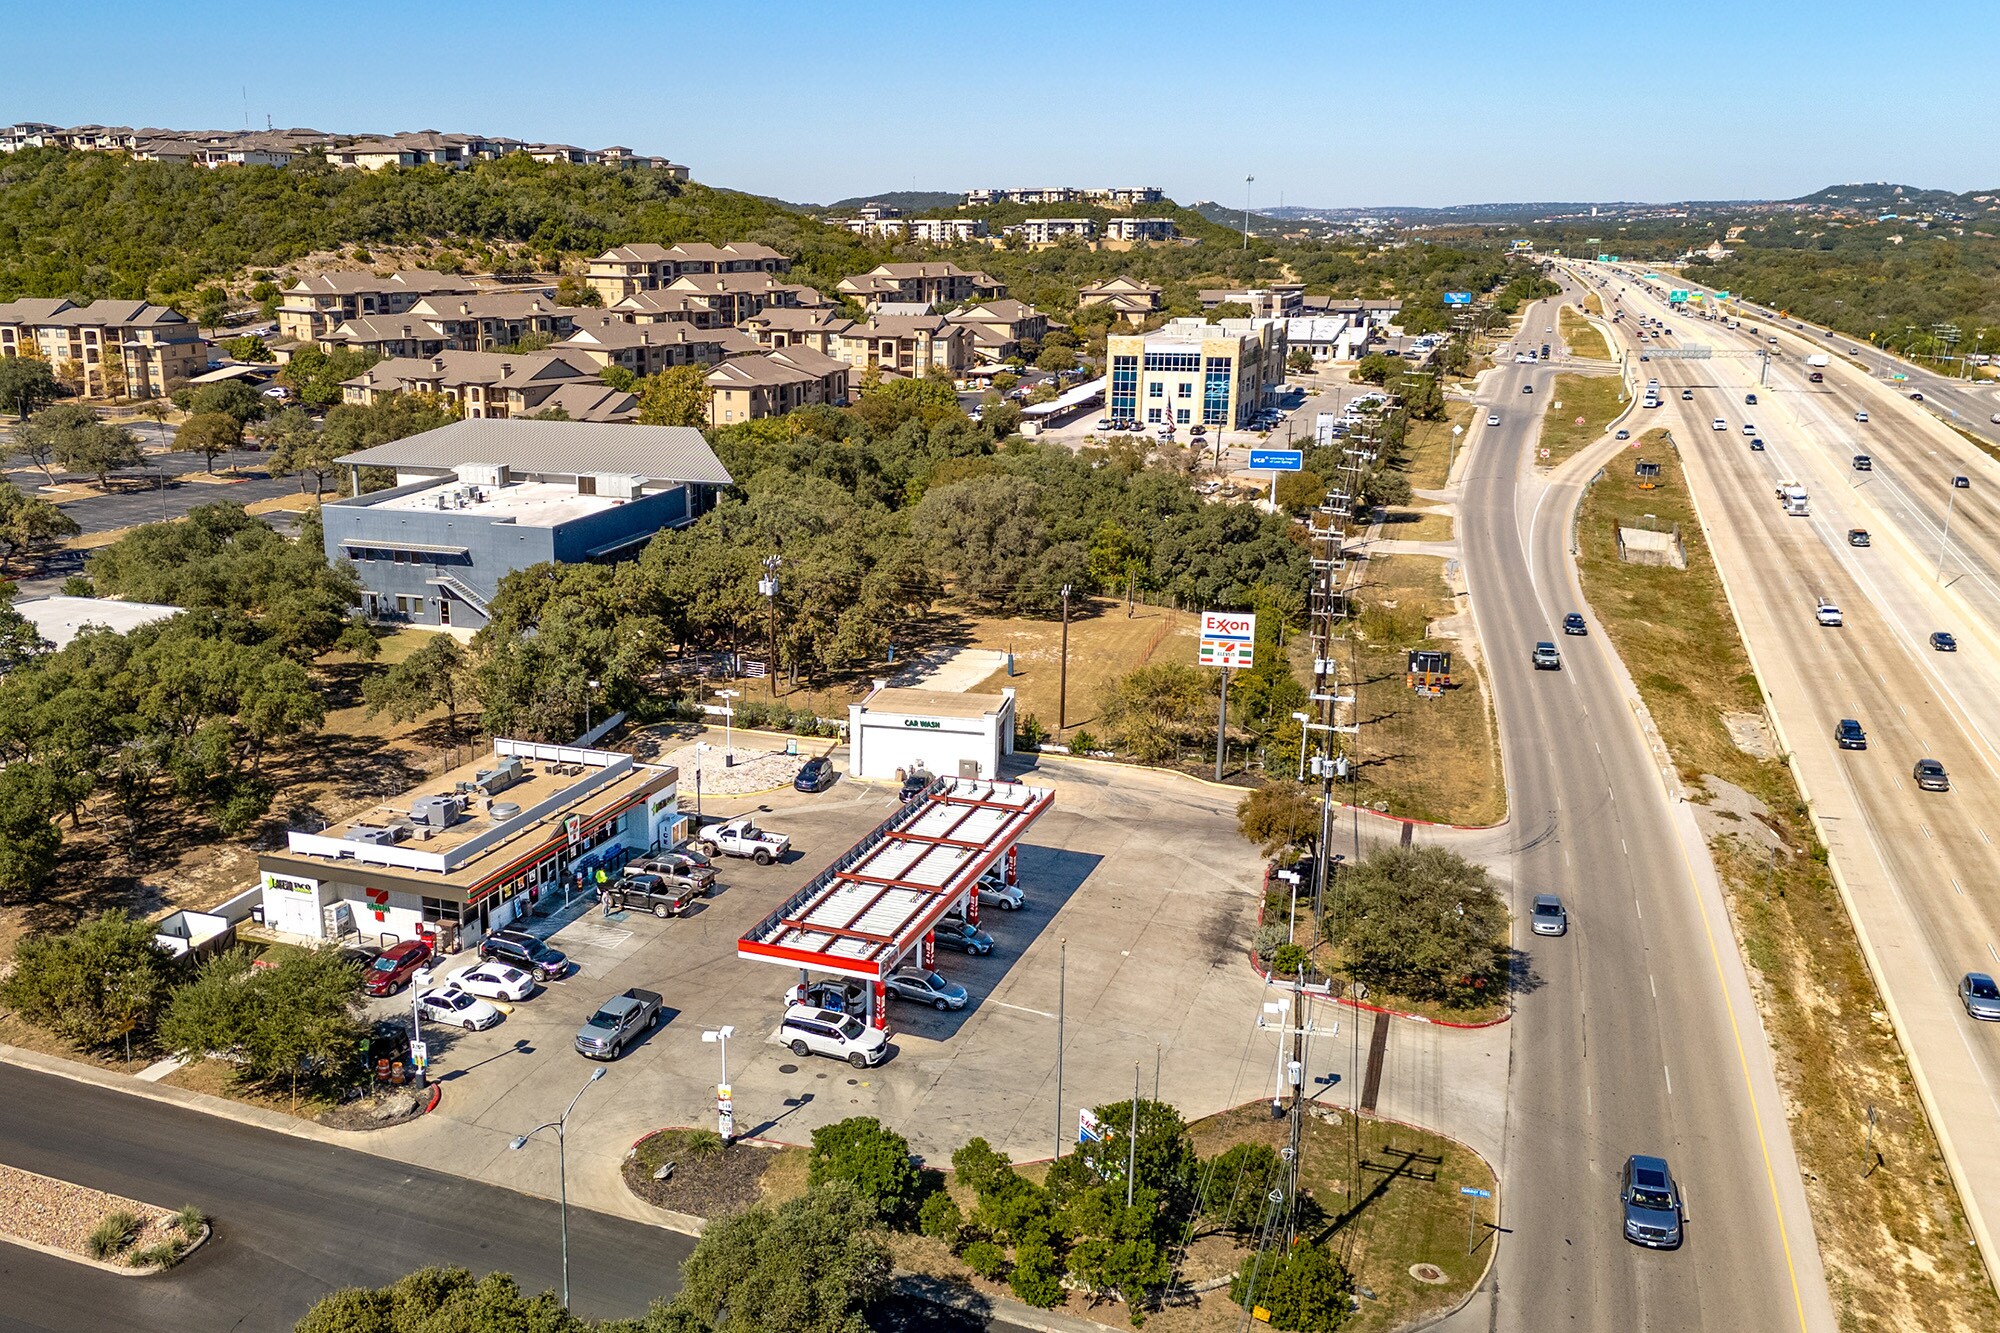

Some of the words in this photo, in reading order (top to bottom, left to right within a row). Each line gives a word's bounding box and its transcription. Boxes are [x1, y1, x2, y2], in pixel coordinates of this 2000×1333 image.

[1207, 617, 1249, 634] Exxon
[904, 719, 918, 727] CAR
[920, 720, 940, 728] WASH
